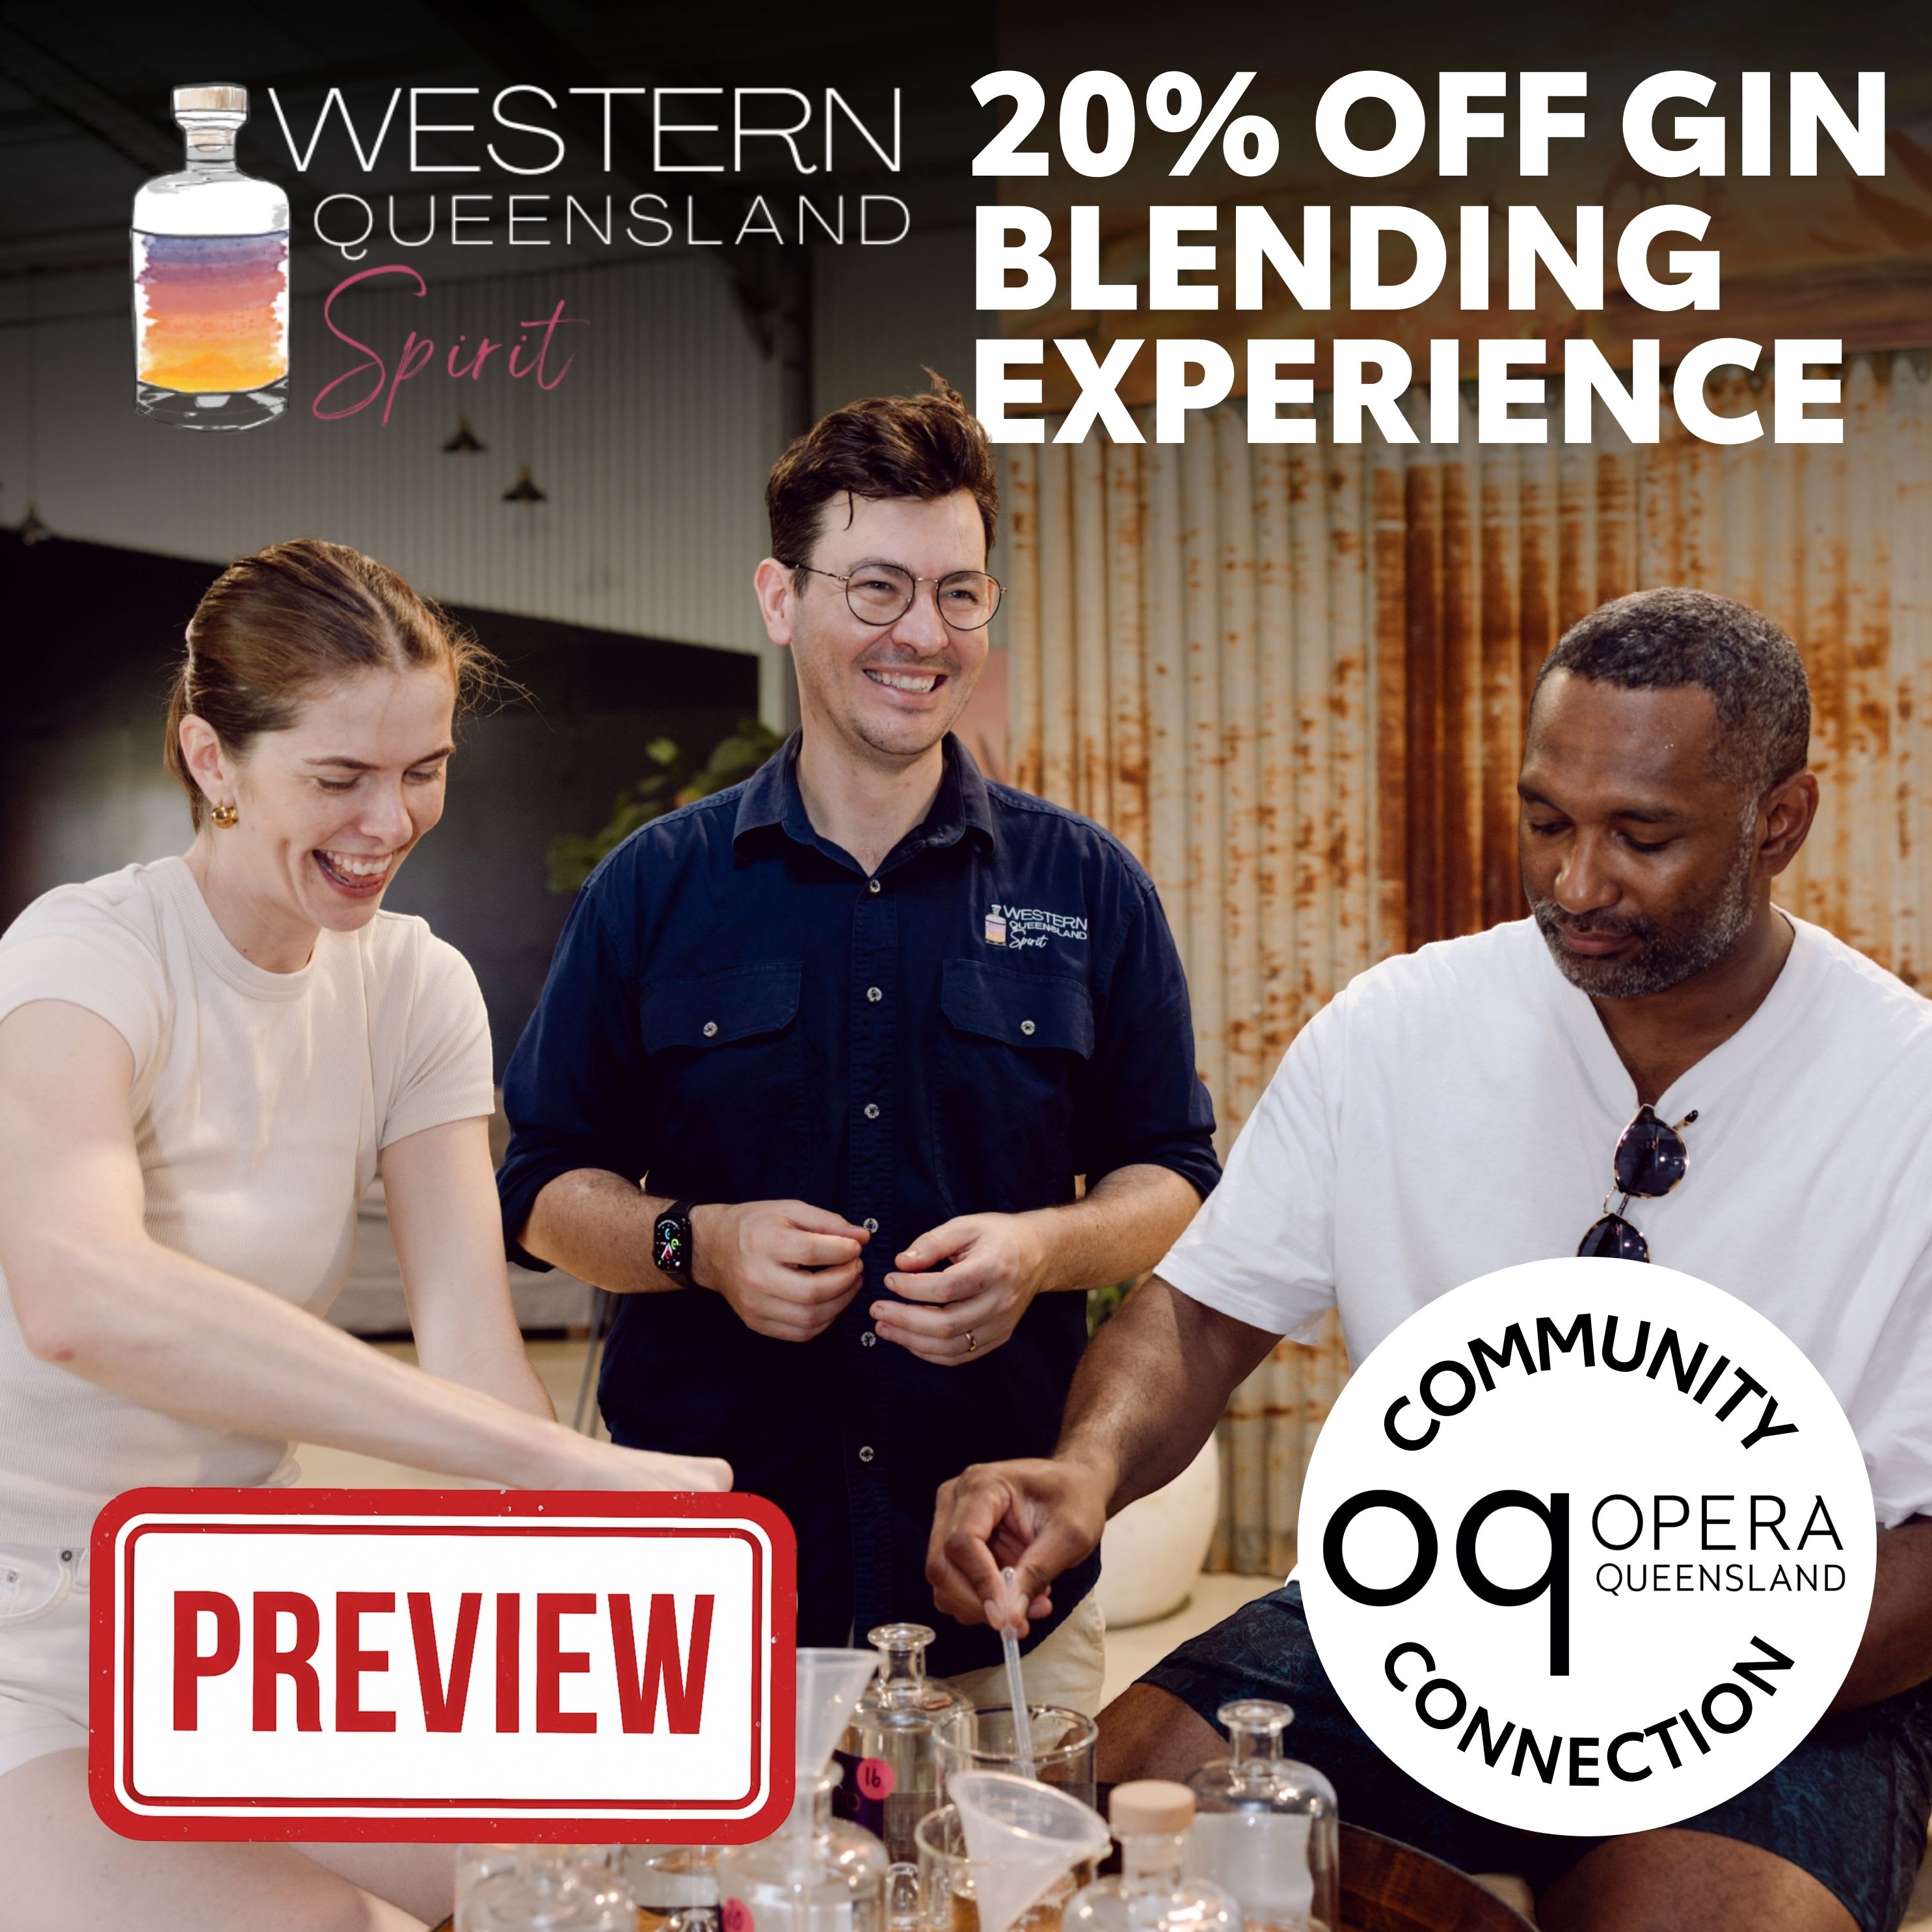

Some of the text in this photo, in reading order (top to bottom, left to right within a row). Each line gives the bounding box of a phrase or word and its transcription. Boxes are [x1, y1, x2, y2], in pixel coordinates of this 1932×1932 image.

[1003, 905, 1088, 931] WESTERN
[1009, 920, 1088, 940] QUEENSLAND
[1009, 929, 1049, 950] Spirit
